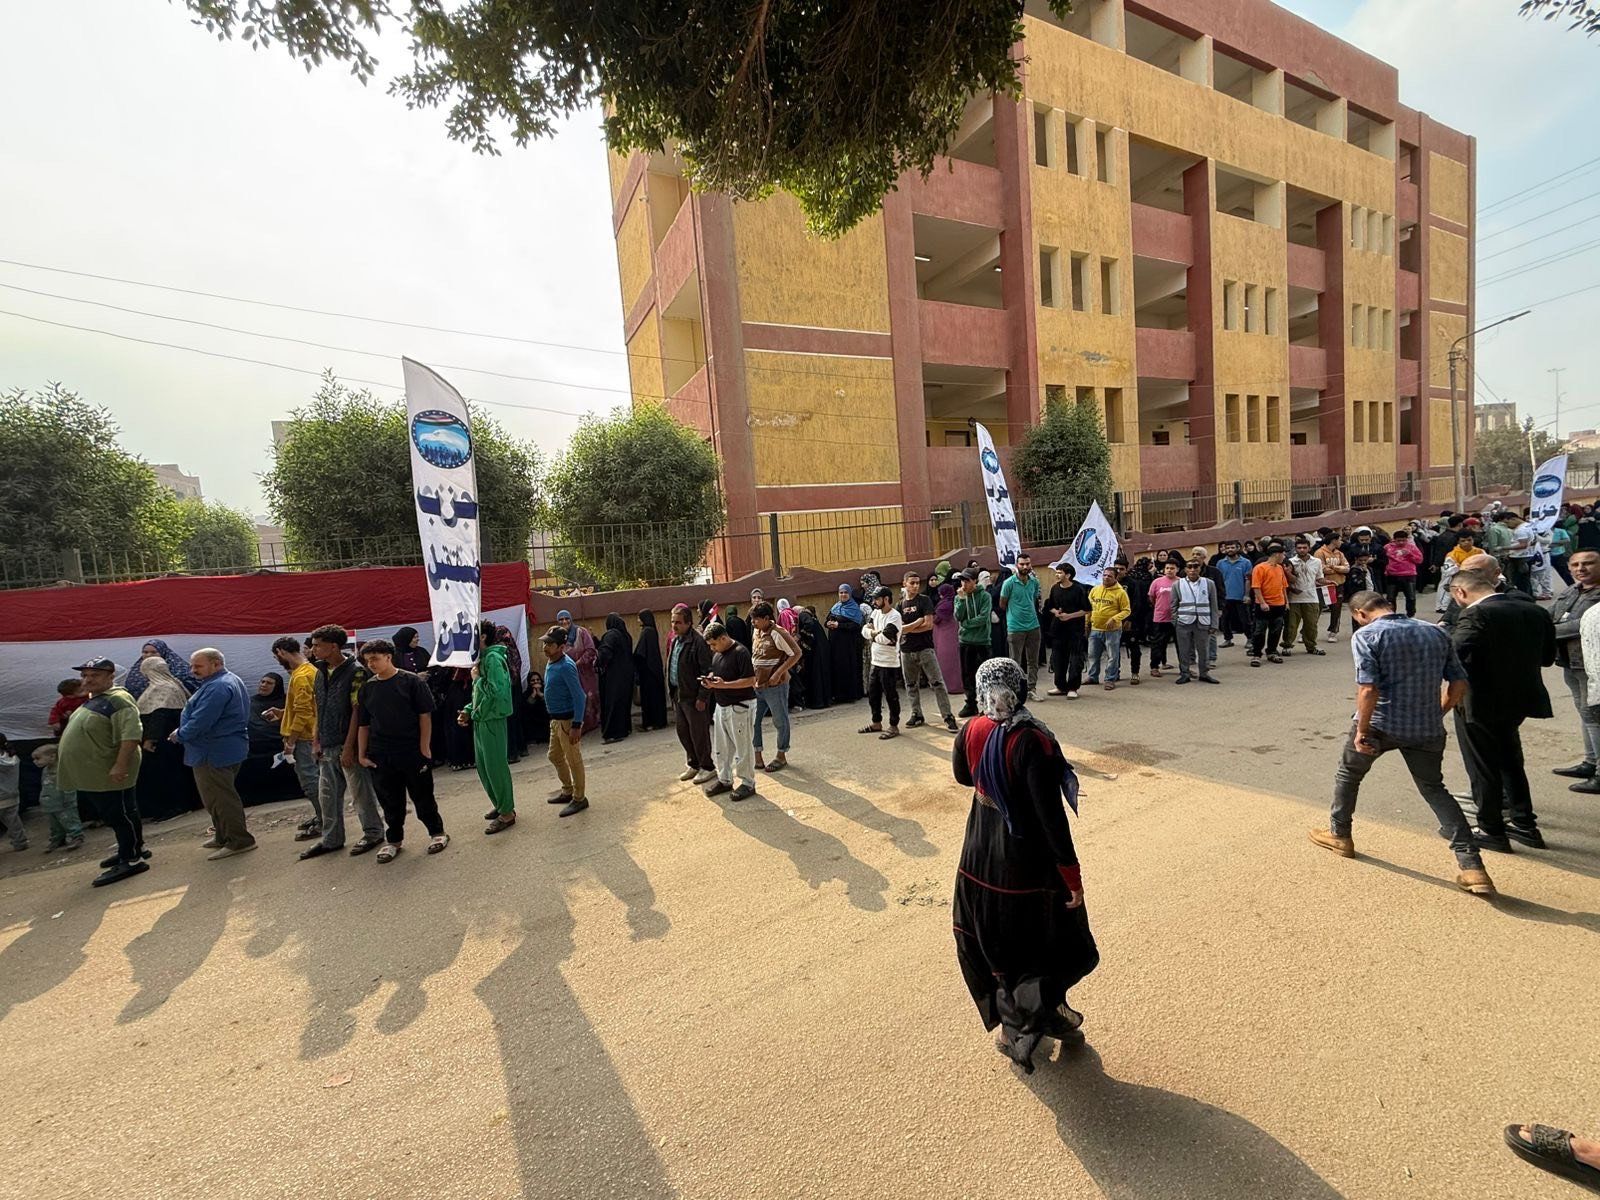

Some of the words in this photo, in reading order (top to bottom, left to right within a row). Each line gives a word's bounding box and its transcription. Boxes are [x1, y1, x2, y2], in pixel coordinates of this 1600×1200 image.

[417, 486, 477, 528] حزب
[985, 484, 1008, 503] حزب
[993, 511, 1017, 537] مستقبل
[428, 544, 480, 592] مستقبل
[436, 611, 480, 662] وطن
